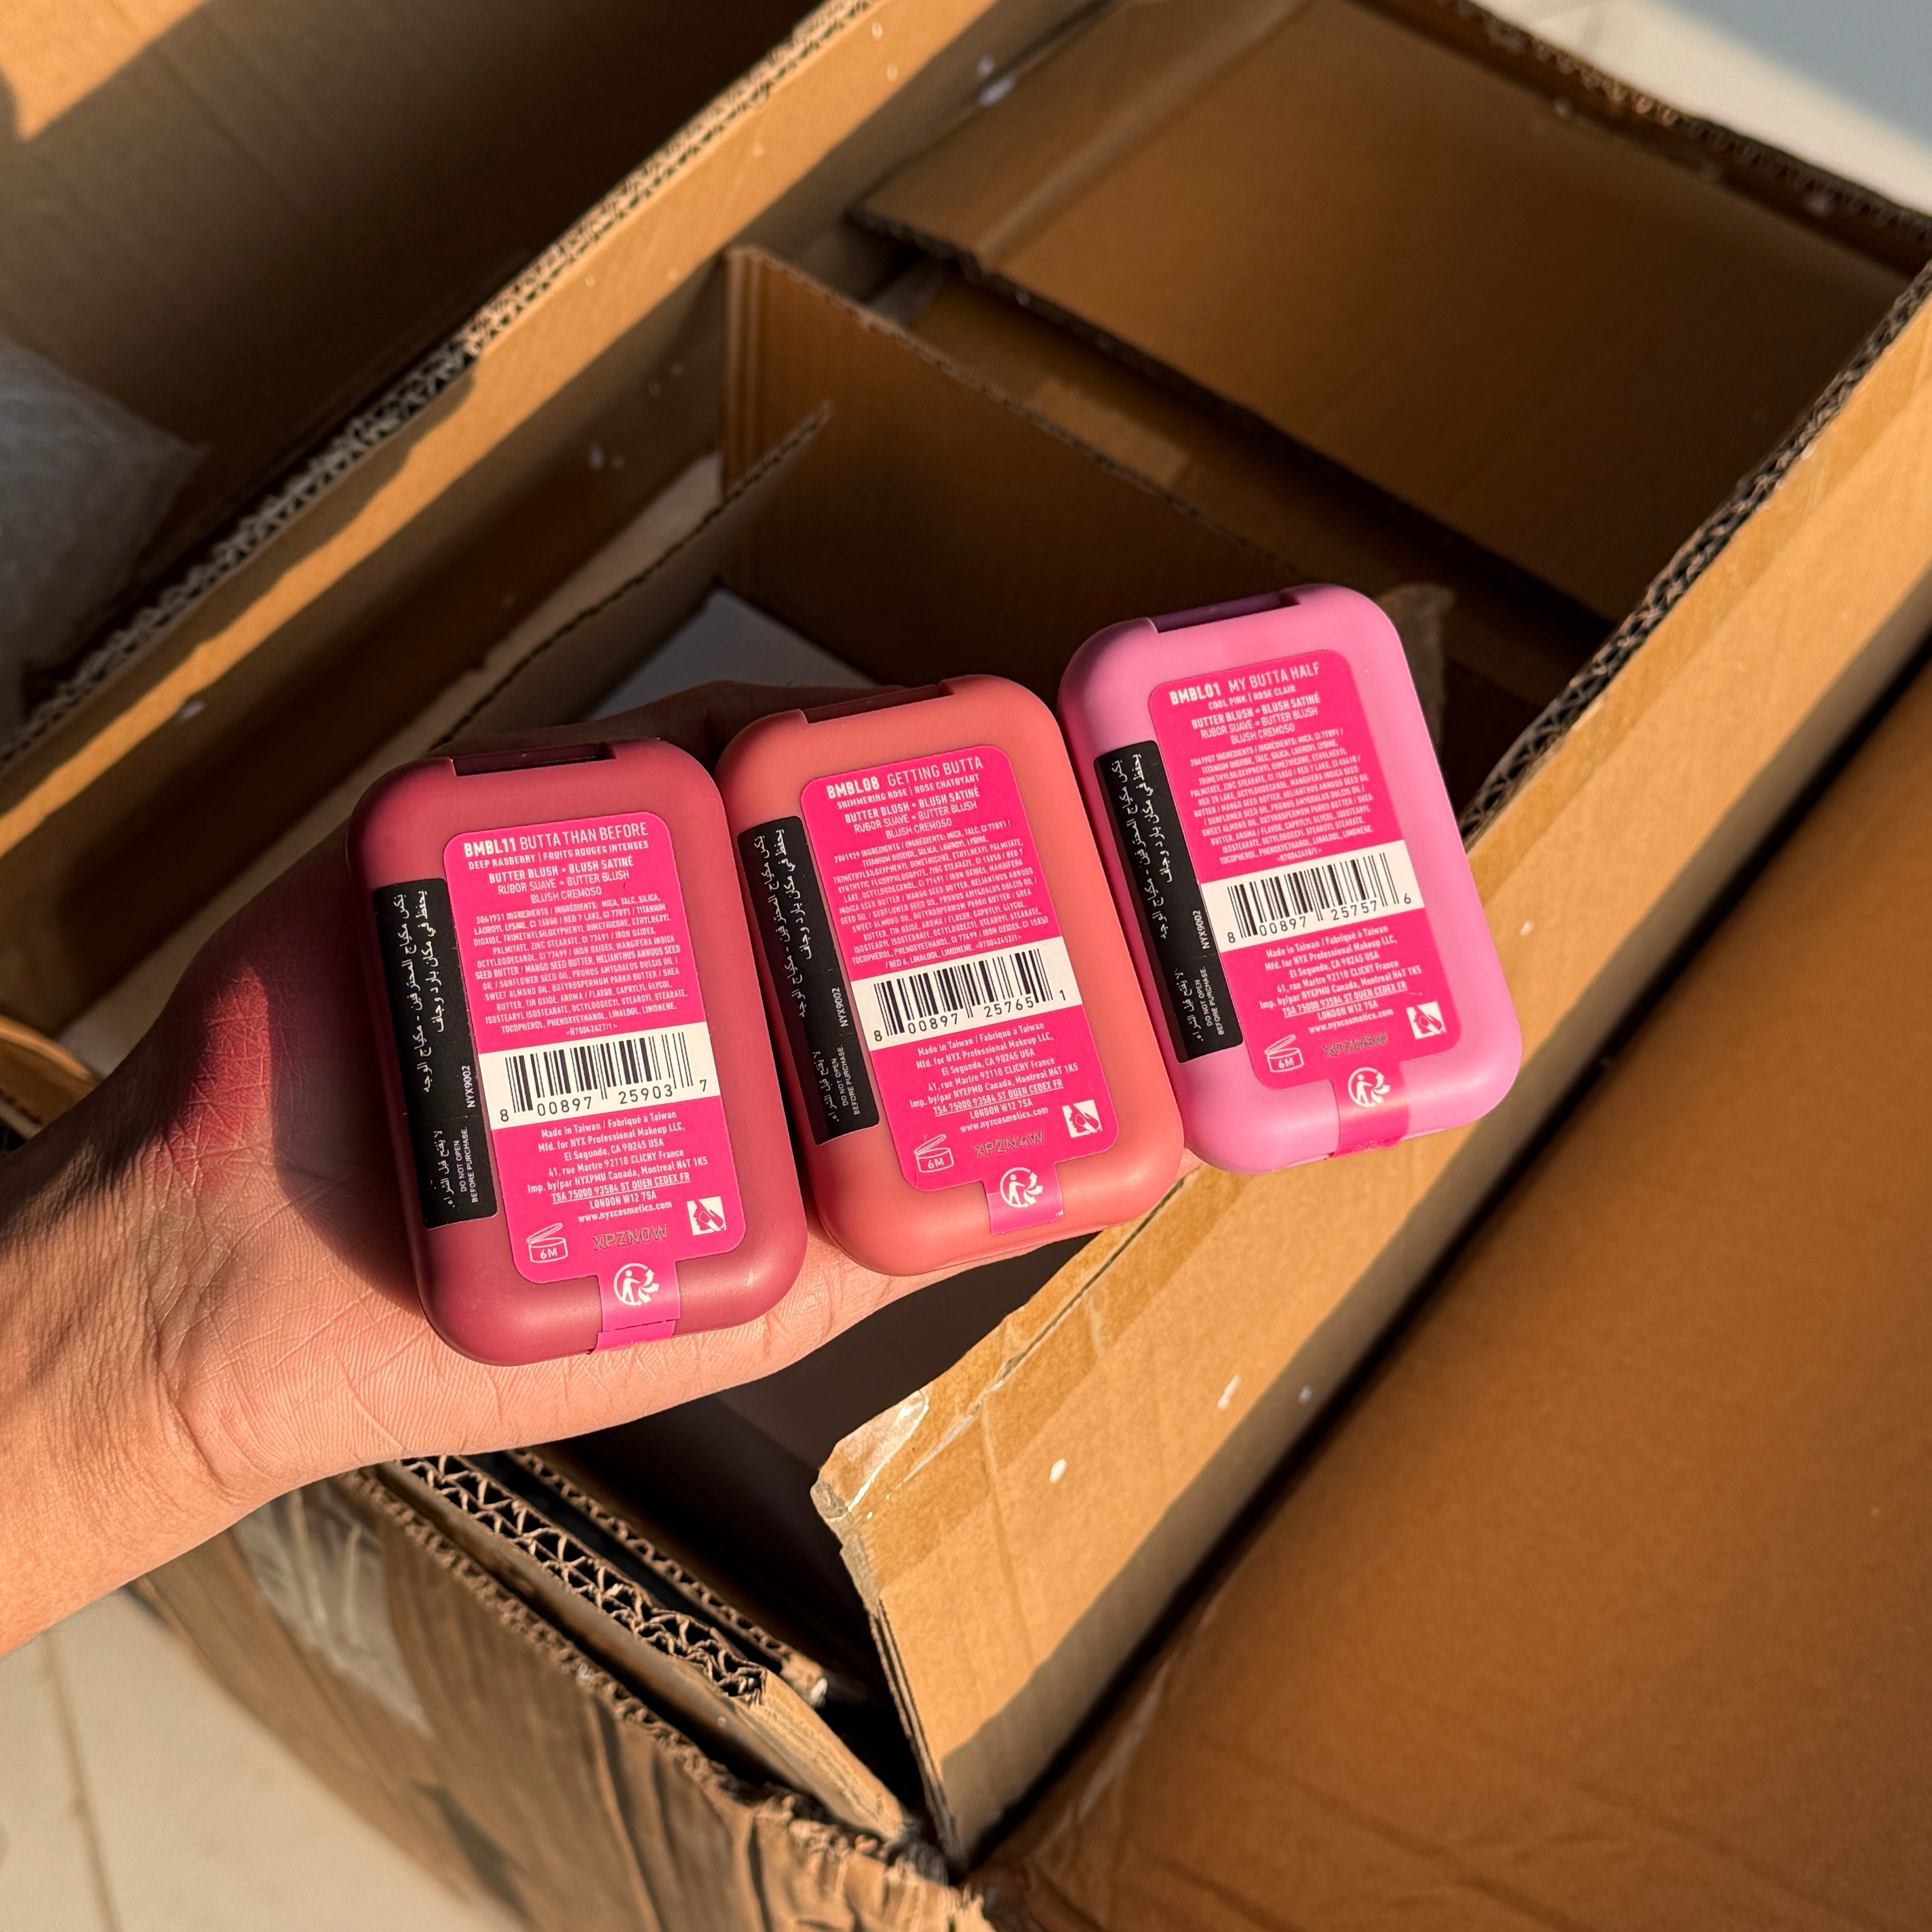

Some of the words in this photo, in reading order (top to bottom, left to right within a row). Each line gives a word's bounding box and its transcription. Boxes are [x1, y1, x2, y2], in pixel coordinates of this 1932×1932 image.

[1168, 682, 1221, 705] BMBL01
[1228, 676, 1246, 693] MY
[1248, 668, 1289, 689] BUTTA
[1289, 661, 1319, 680] HALF
[1207, 699, 1228, 710] COOL
[1228, 695, 1247, 706] PINK
[1252, 689, 1273, 701] ROSE
[1273, 684, 1296, 696] CLAIR
[1191, 713, 1225, 729] BUTTER
[1224, 707, 1254, 722] BLUSH
[1260, 699, 1291, 715] BLUSH
[1290, 691, 1320, 708] SATINÉ
[1200, 724, 1228, 739] RUBOR
[1228, 719, 1254, 733] SUAVE
[1260, 711, 1292, 727] BUTTER
[1292, 706, 1318, 720] BLUSH
[1230, 731, 1257, 745] BLUSH
[1257, 722, 1295, 739] CREMOSO
[826, 776, 880, 799] BMBL08
[887, 764, 940, 787] GETTING
[942, 756, 983, 776] BUTTA
[837, 792, 886, 809] SHIMMERING
[887, 787, 908, 799] ROSE
[914, 782, 935, 794] ROSE
[935, 773, 979, 789] CHATOYANT
[844, 808, 879, 823] BUTTER
[879, 801, 910, 816] BLUSH
[918, 794, 948, 809] BLUSH
[948, 785, 980, 802] SATINÉ
[853, 819, 882, 833] RUBOR
[883, 814, 910, 827] SUAVE
[917, 805, 950, 820] BUTTER
[950, 800, 977, 814] BLUSH
[463, 837, 516, 858] BMBL11
[519, 832, 561, 851] BUTTA
[561, 828, 597, 845] THAN
[598, 821, 649, 841] BEFORE
[885, 825, 913, 839] BLUSH
[913, 817, 952, 833] CREMOSO
[468, 859, 490, 870] DEEP
[543, 849, 574, 860] FRUITS
[574, 845, 607, 857] ROUGES
[608, 840, 649, 853] INTENSES
[488, 869, 526, 884] BUTTER
[527, 865, 559, 879] BLUSH
[568, 860, 599, 874] BLUSH
[600, 854, 634, 870] SATINÉ
[497, 882, 527, 895] RUBOR
[529, 878, 557, 891] SUAVE
[566, 872, 600, 887] BUTTER
[601, 869, 630, 882] BLUSH
[530, 891, 559, 904] BLUSH
[560, 885, 602, 900] CREMOSO
[415, 890, 428, 919] يحفظ
[1227, 932, 1235, 943] 8
[1403, 893, 1411, 904] 6
[397, 923, 417, 954] مكياج
[417, 922, 436, 937] في
[1192, 910, 1210, 949] NYX9002
[420, 941, 438, 967] مكان
[401, 959, 423, 1010] المحترفين
[831, 987, 849, 1027] NYX9002
[874, 1030, 882, 1041] 8
[1059, 989, 1066, 1001] 1
[1308, 1008, 1394, 1034] www.nyxcosmetics.com
[1316, 1006, 1347, 1021] LONDON
[1346, 1002, 1363, 1014] W12
[1363, 999, 1379, 1010] 7SA
[412, 1025, 432, 1057] مكياج
[417, 1062, 432, 1092] الوجه
[1278, 1057, 1294, 1069] 6M
[461, 1065, 476, 1108] NYX9002
[500, 1109, 509, 1122] 8
[699, 1079, 706, 1091] 7
[959, 1107, 1049, 1133] www.nyxcosmetics.com
[969, 1104, 1000, 1119] LONDON
[999, 1101, 1017, 1112] W12
[1017, 1097, 1033, 1108] 7SA
[538, 1141, 556, 1152] Mfd.
[556, 1140, 569, 1150] for
[570, 1136, 586, 1147] NYX
[587, 1128, 636, 1145] Professional
[636, 1126, 667, 1136] Makeup
[668, 1121, 685, 1132] LLC,
[541, 1127, 562, 1138] Made
[563, 1126, 572, 1135] in
[572, 1122, 601, 1133] Taiwan
[642, 1113, 649, 1123] à
[649, 1111, 677, 1122] Taiwan
[453, 1140, 462, 1161] OPEN
[460, 1126, 473, 1170] PURCHASE.
[548, 1167, 561, 1177] 41,
[561, 1166, 575, 1175] rue
[576, 1161, 603, 1173] Martre
[603, 1155, 629, 1168] 92110
[630, 1150, 656, 1164] CLICHY
[658, 1149, 684, 1160] France
[563, 1151, 573, 1161] El
[573, 1146, 610, 1160] Segundo,
[610, 1144, 621, 1154] CA
[621, 1139, 647, 1152] 90245
[647, 1137, 664, 1148] USA
[927, 1157, 944, 1169] 6M
[437, 1160, 449, 1174] قبل
[456, 1164, 465, 1179] NOT
[527, 1184, 546, 1194] Imp.
[546, 1179, 572, 1191] by/par
[574, 1171, 607, 1186] NYXPMU
[607, 1168, 640, 1180] Canada,
[640, 1160, 676, 1175] Montreal
[692, 1155, 708, 1167] 1K5
[459, 1180, 467, 1192] DO
[467, 1171, 478, 1203] BEFORE
[550, 1191, 568, 1202] TSA
[567, 1187, 593, 1200] 75000
[593, 1183, 619, 1195] 93584
[620, 1181, 630, 1191] ST
[631, 1177, 653, 1189] OUEN
[653, 1173, 679, 1185] CEDEX
[679, 1171, 690, 1181] FR
[589, 1195, 621, 1210] LONDON
[621, 1192, 639, 1204] W12
[640, 1189, 657, 1201] 7SA
[577, 1201, 672, 1223] www.nyxcosmetics.com
[539, 1247, 557, 1260] 6M
